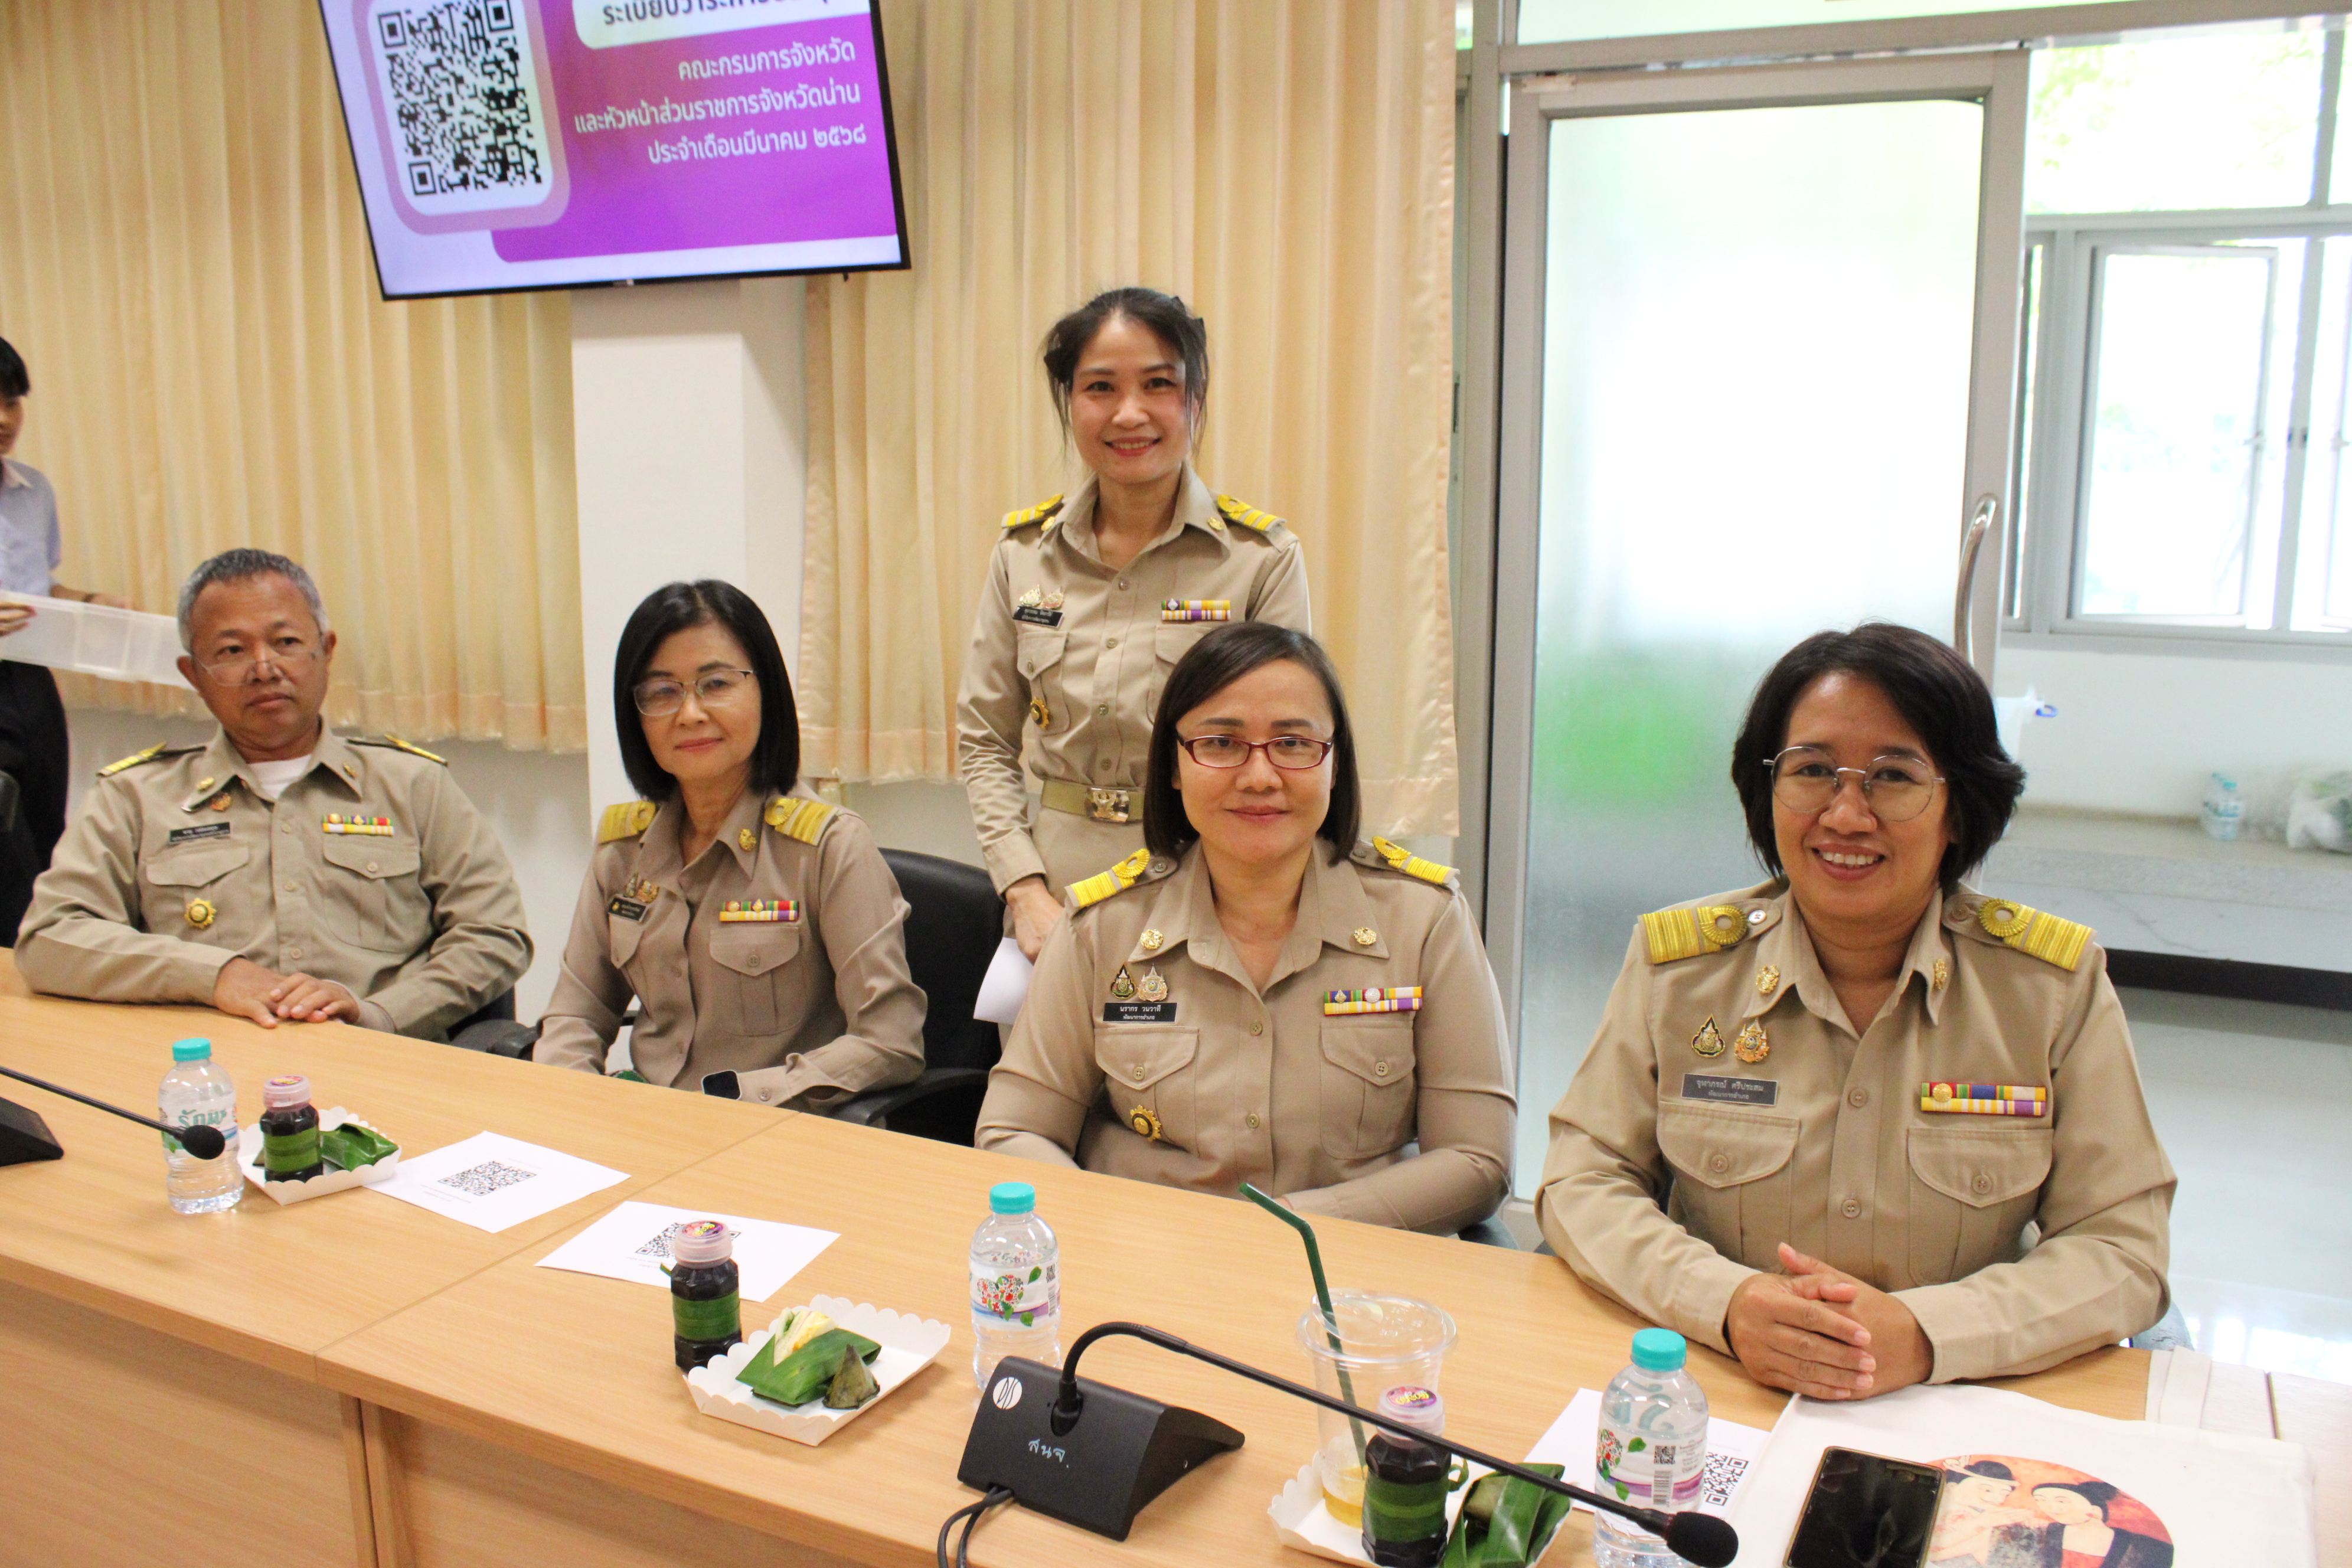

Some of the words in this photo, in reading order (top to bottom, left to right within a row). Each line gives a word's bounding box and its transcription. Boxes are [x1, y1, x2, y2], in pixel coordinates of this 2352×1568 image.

[678, 36, 855, 81] คณะกรมการจังหวัด
[574, 77, 861, 133] และหัวหน้าส่วนราชการจังหวัดน่าน
[648, 129, 807, 164] ประจำเดือนมีนาคม
[814, 123, 867, 149] ๒๕๖๘
